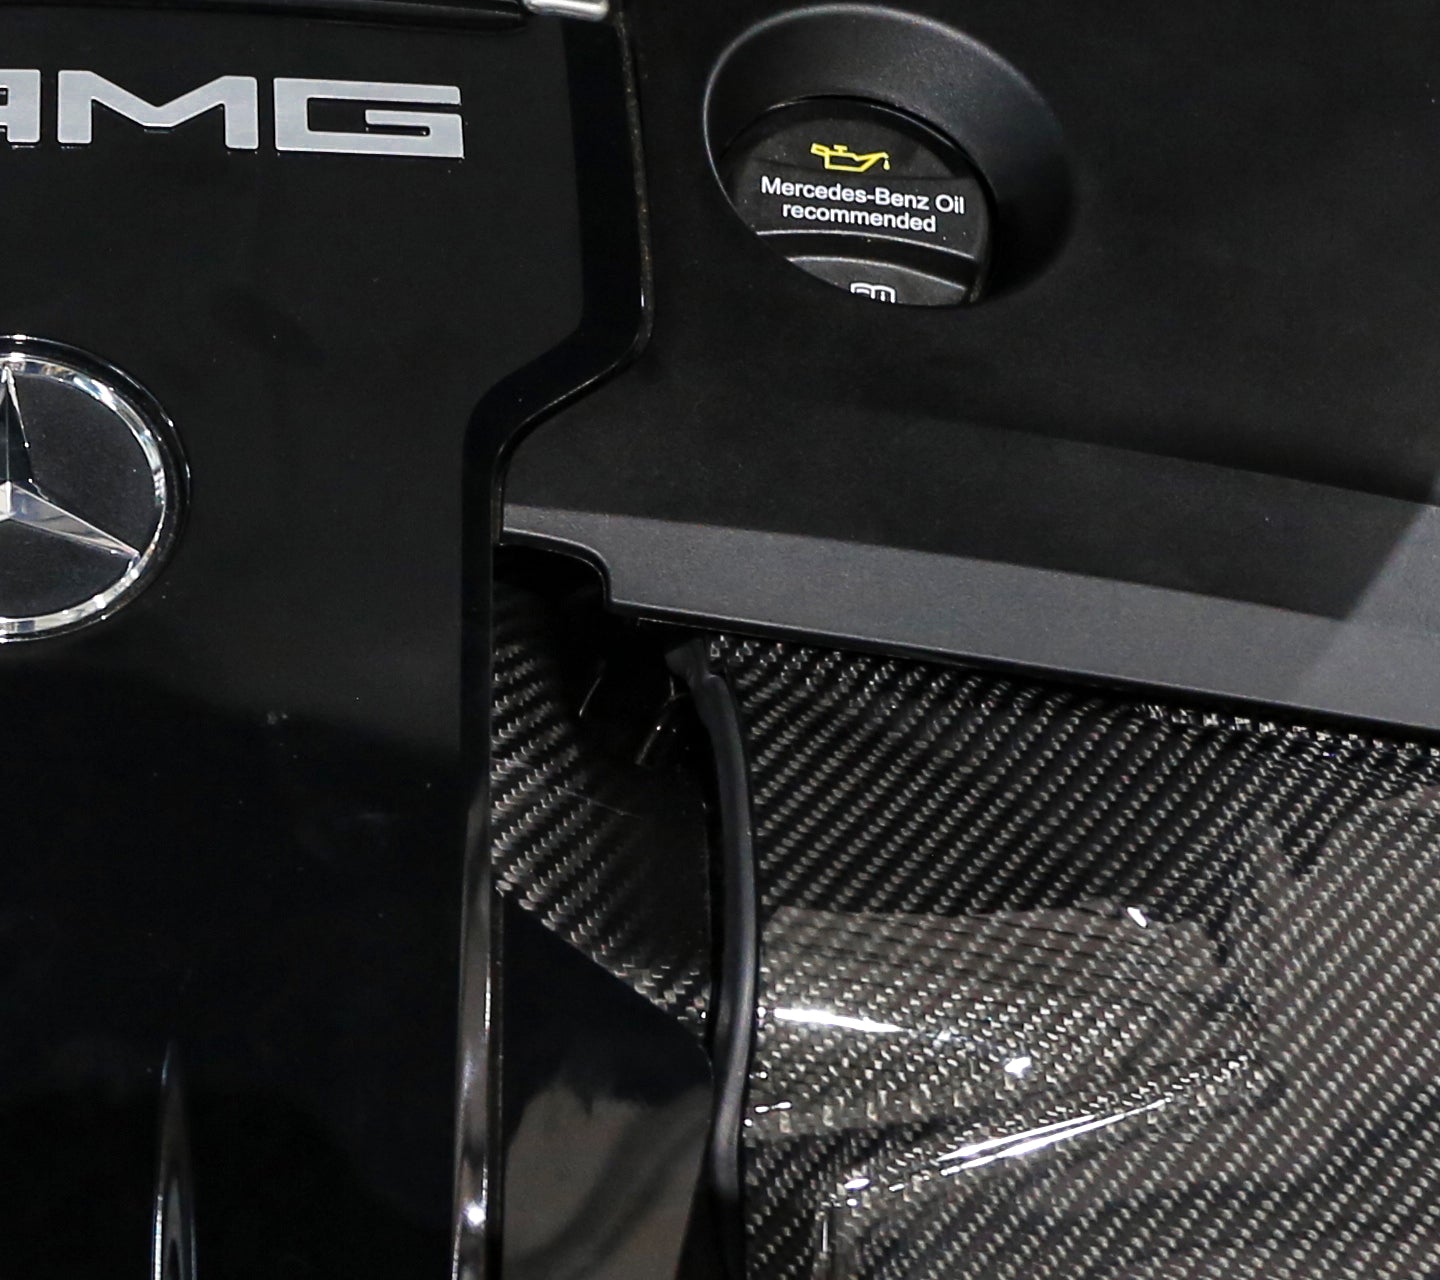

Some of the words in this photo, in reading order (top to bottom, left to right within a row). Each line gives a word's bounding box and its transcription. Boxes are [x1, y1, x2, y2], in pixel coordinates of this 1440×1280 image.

[760, 175, 930, 211] Mercedes-Benz
[935, 193, 965, 215] Oil
[782, 201, 937, 233] recommended
